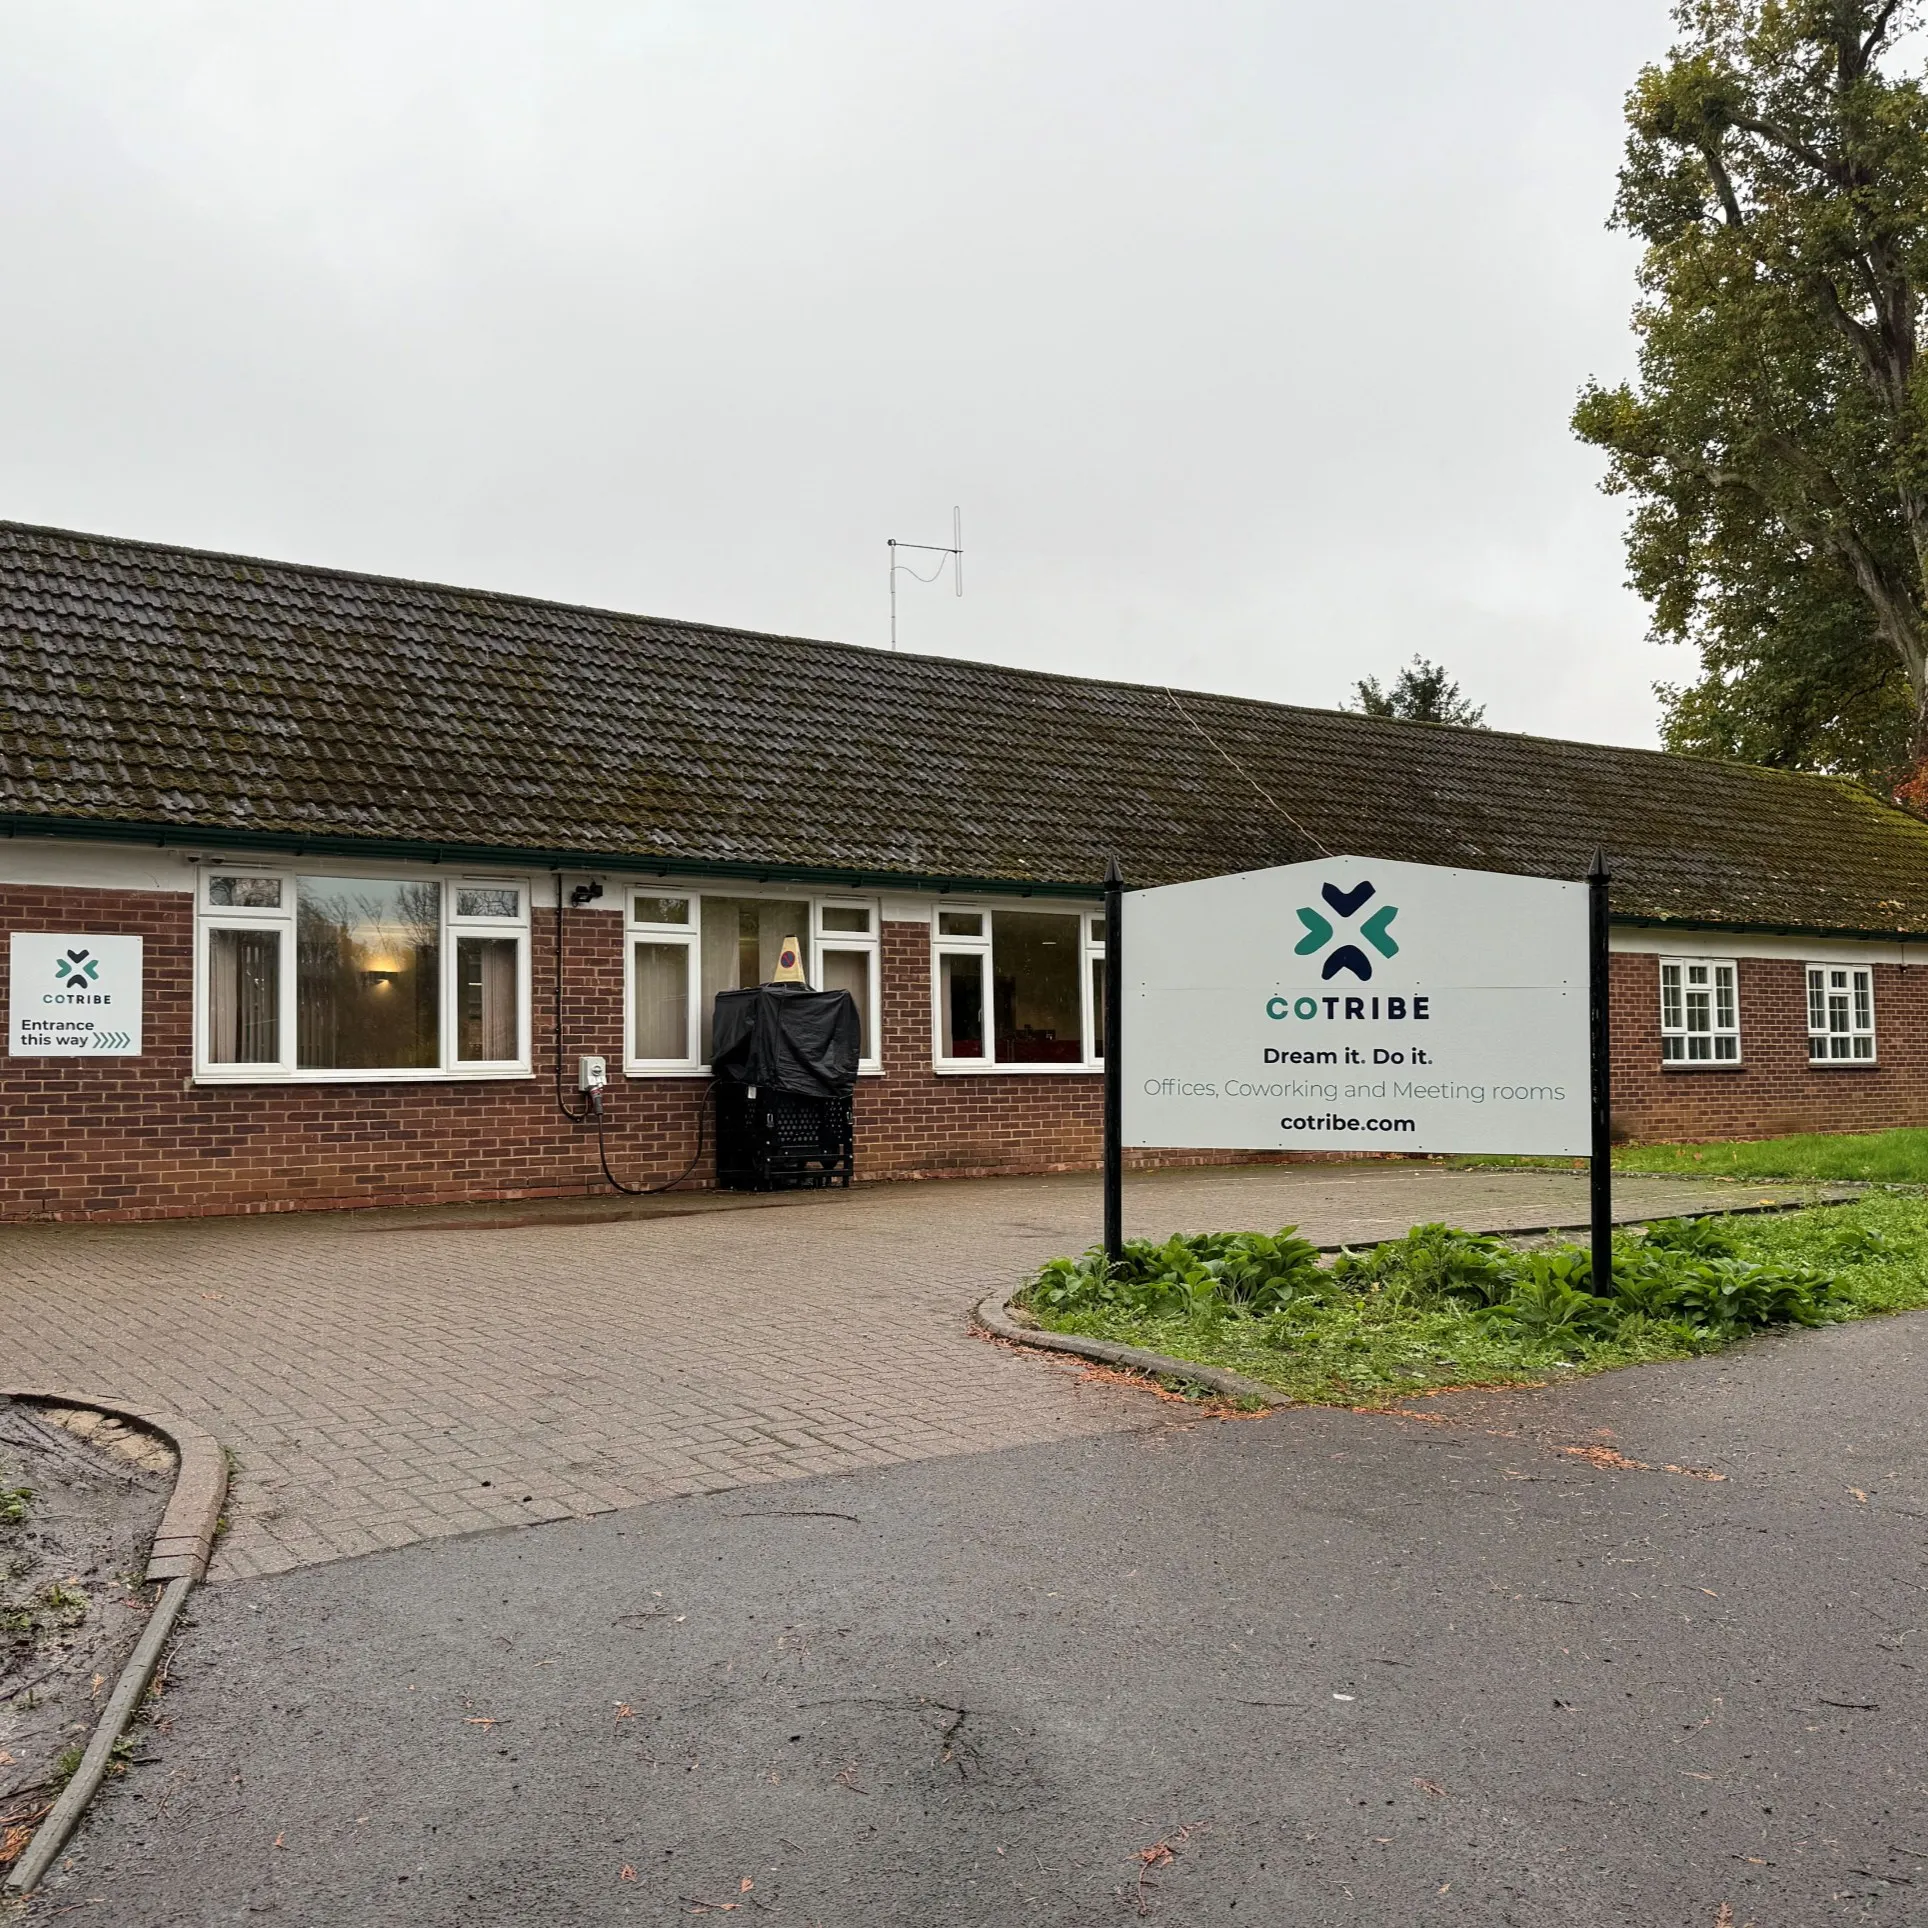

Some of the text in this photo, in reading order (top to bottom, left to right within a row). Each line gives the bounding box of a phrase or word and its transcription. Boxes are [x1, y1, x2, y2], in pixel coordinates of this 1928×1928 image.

[43, 994, 111, 1004] COTRIBE
[1266, 996, 1430, 1020] COTRIBE
[21, 1019, 94, 1031] Entrance
[20, 1033, 88, 1048] this way
[1263, 1047, 1433, 1065] Dream it. Do it.
[1143, 1078, 1566, 1104] Offices, Coworking and Meeting rooms
[1280, 1112, 1416, 1132] cotribe.com
